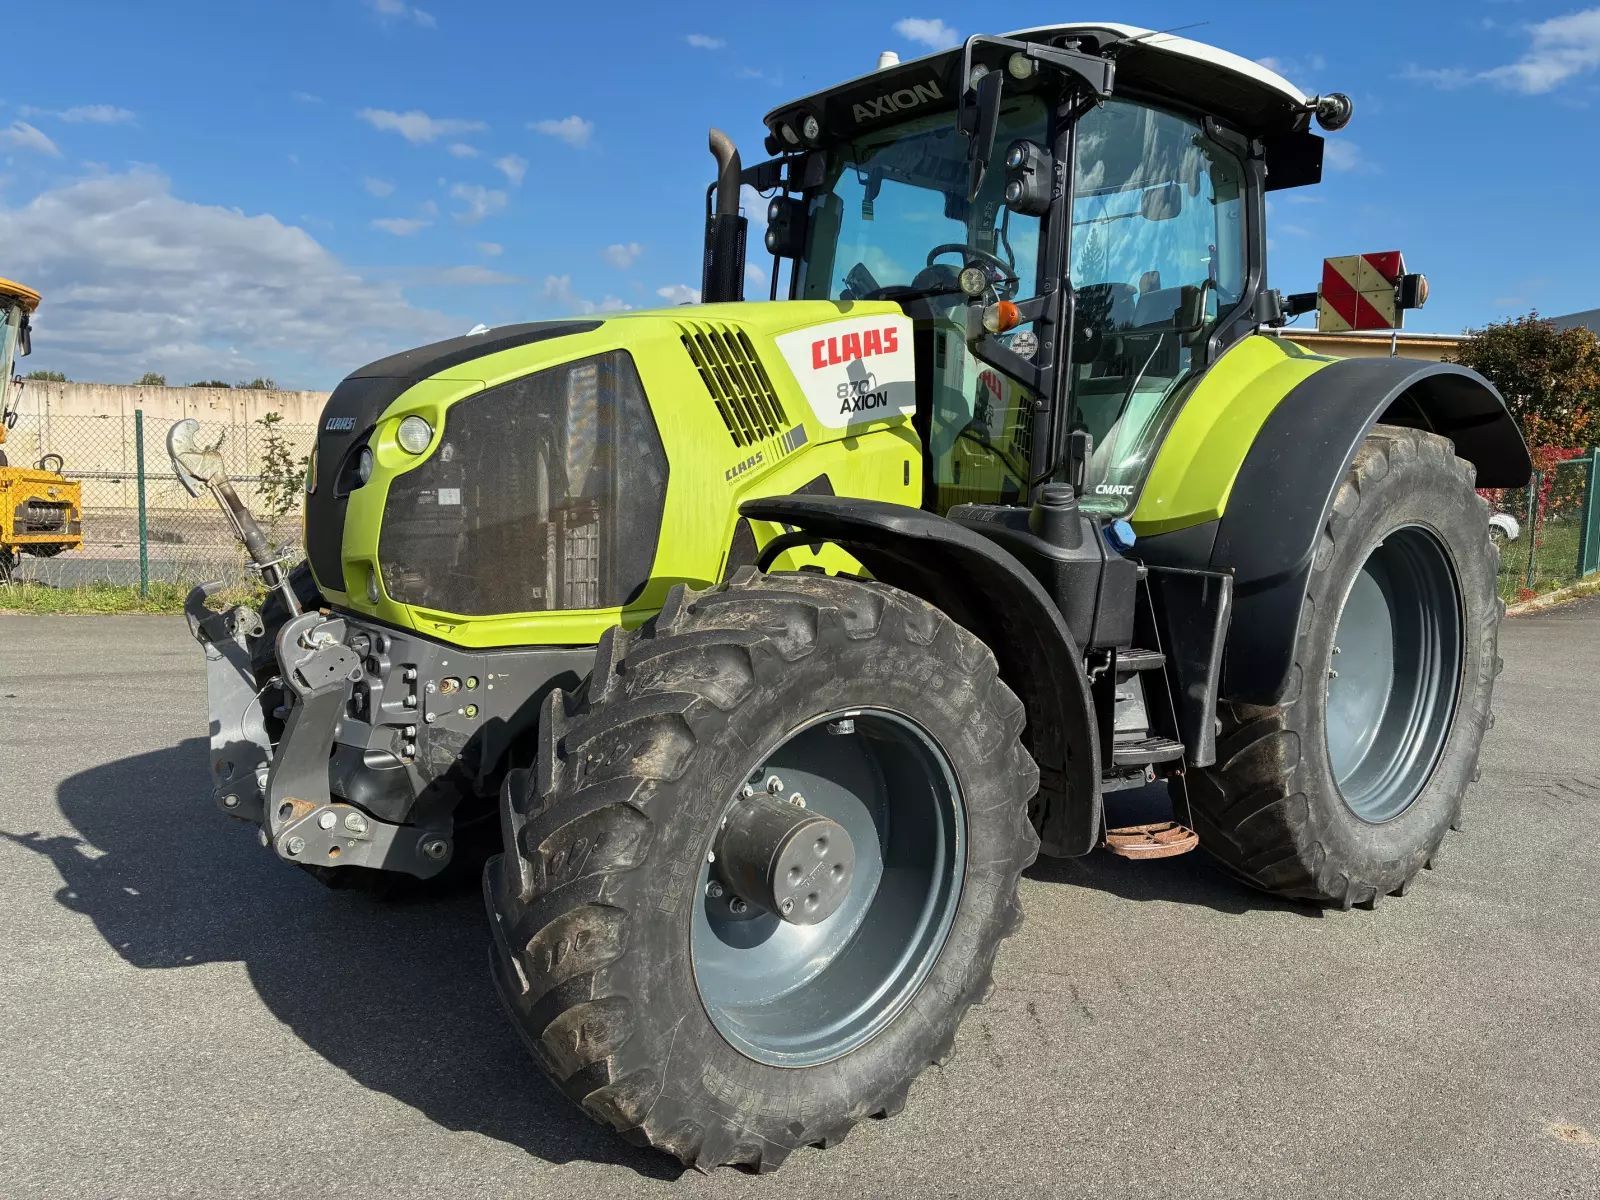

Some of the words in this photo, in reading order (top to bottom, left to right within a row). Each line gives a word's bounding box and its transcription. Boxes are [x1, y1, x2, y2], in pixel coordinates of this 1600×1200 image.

[852, 80, 944, 123] AXION
[812, 327, 898, 370] CLAAS
[836, 379, 870, 399] 870
[840, 390, 888, 415] AXION
[325, 417, 355, 430] CLAAS
[725, 450, 763, 481] CLAAS
[1095, 484, 1134, 495] CMATIC
